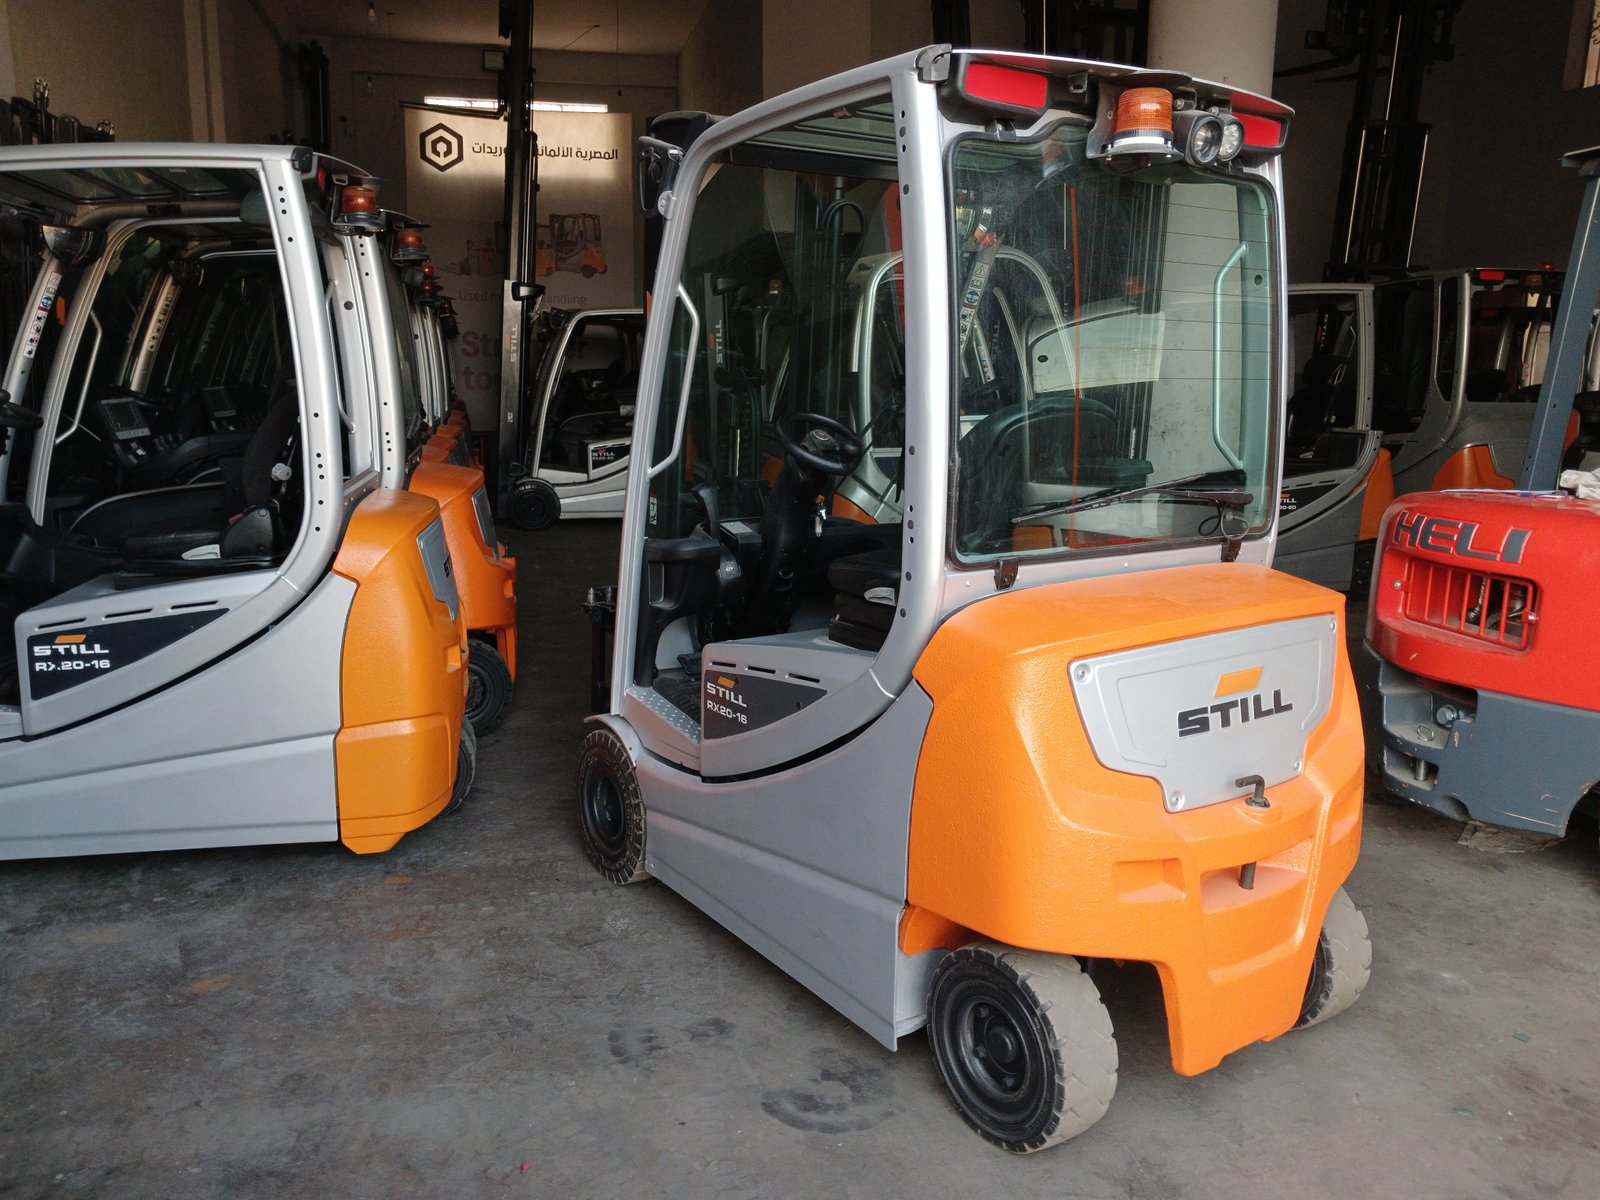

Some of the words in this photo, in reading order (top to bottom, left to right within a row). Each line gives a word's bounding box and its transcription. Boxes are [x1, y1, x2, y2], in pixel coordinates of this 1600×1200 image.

[537, 145, 572, 158] الألمان
[575, 147, 618, 161] المصرية
[458, 290, 488, 303] Used
[510, 323, 518, 363] STILL
[715, 319, 723, 364] STILL
[1393, 509, 1533, 563] HELI
[33, 643, 110, 656] STILL
[706, 682, 748, 708] STILL
[706, 700, 748, 725] RX20-16
[1177, 688, 1294, 738] STILL
